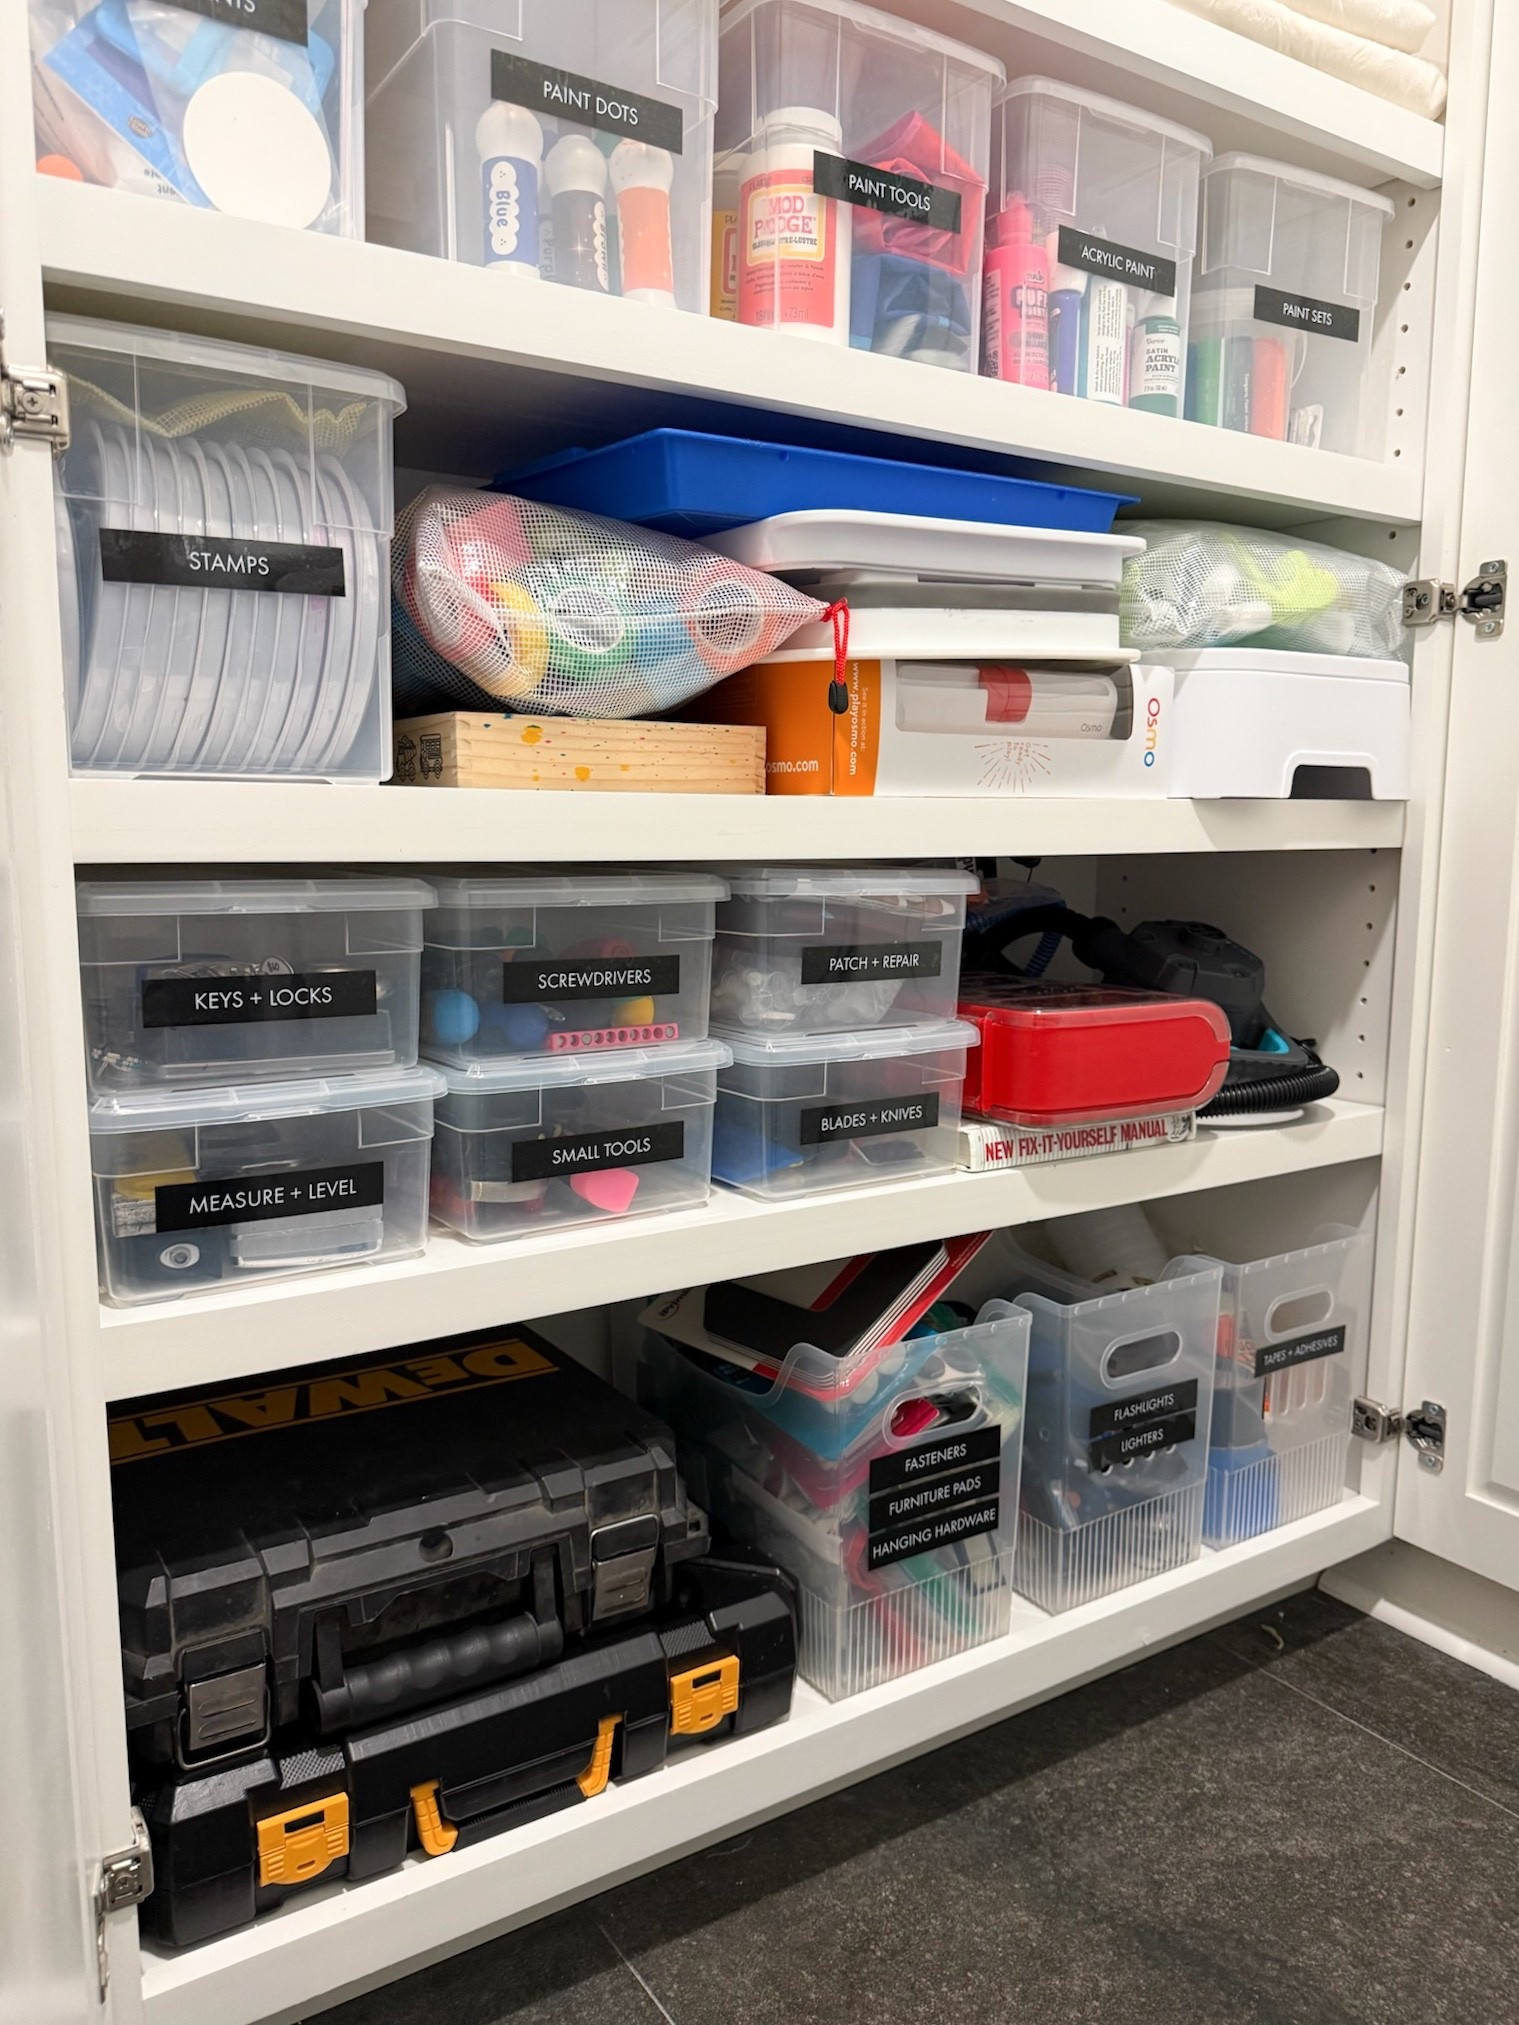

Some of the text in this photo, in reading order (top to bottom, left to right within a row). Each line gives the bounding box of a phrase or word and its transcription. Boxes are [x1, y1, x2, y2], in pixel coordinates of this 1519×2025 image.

[544, 80, 639, 125] PAINT DOTS
[849, 174, 931, 212] PAINT TOOLS
[496, 190, 511, 228] Blue
[540, 239, 555, 278] Purpl
[1081, 245, 1155, 280] ACRYLIC PAINT
[1283, 302, 1333, 326] PAINT SETS
[1145, 363, 1176, 373] PAINT
[189, 552, 270, 576] STAMPS
[849, 662, 861, 776] www.playosmo.com
[1081, 723, 1102, 732] Osmo
[1144, 698, 1160, 767] Osmo
[766, 759, 819, 774] osmo.com
[829, 953, 920, 972] PATCH + REPAIR
[538, 969, 651, 989] SCREWDRIVERS
[195, 986, 333, 1010] KEYS + LOCKS
[821, 1105, 923, 1132] BLADES + KNIVES
[552, 1137, 651, 1165] SMALL TOOLS
[986, 1119, 1168, 1162] NEW FIX-IT-YOURSELF MANUAL
[189, 1179, 357, 1214] MEASURE + LEVEL
[1263, 1350, 1287, 1366] TAPES
[1294, 1335, 1338, 1357] ADHESIVES
[1114, 1394, 1174, 1422] FLASHLIGHTS
[1121, 1428, 1164, 1453] LIGHTERS
[904, 1443, 967, 1473] FASTENERS
[888, 1475, 982, 1516] FURNITURE PADS
[872, 1508, 996, 1560] HANGING HARDWARE
